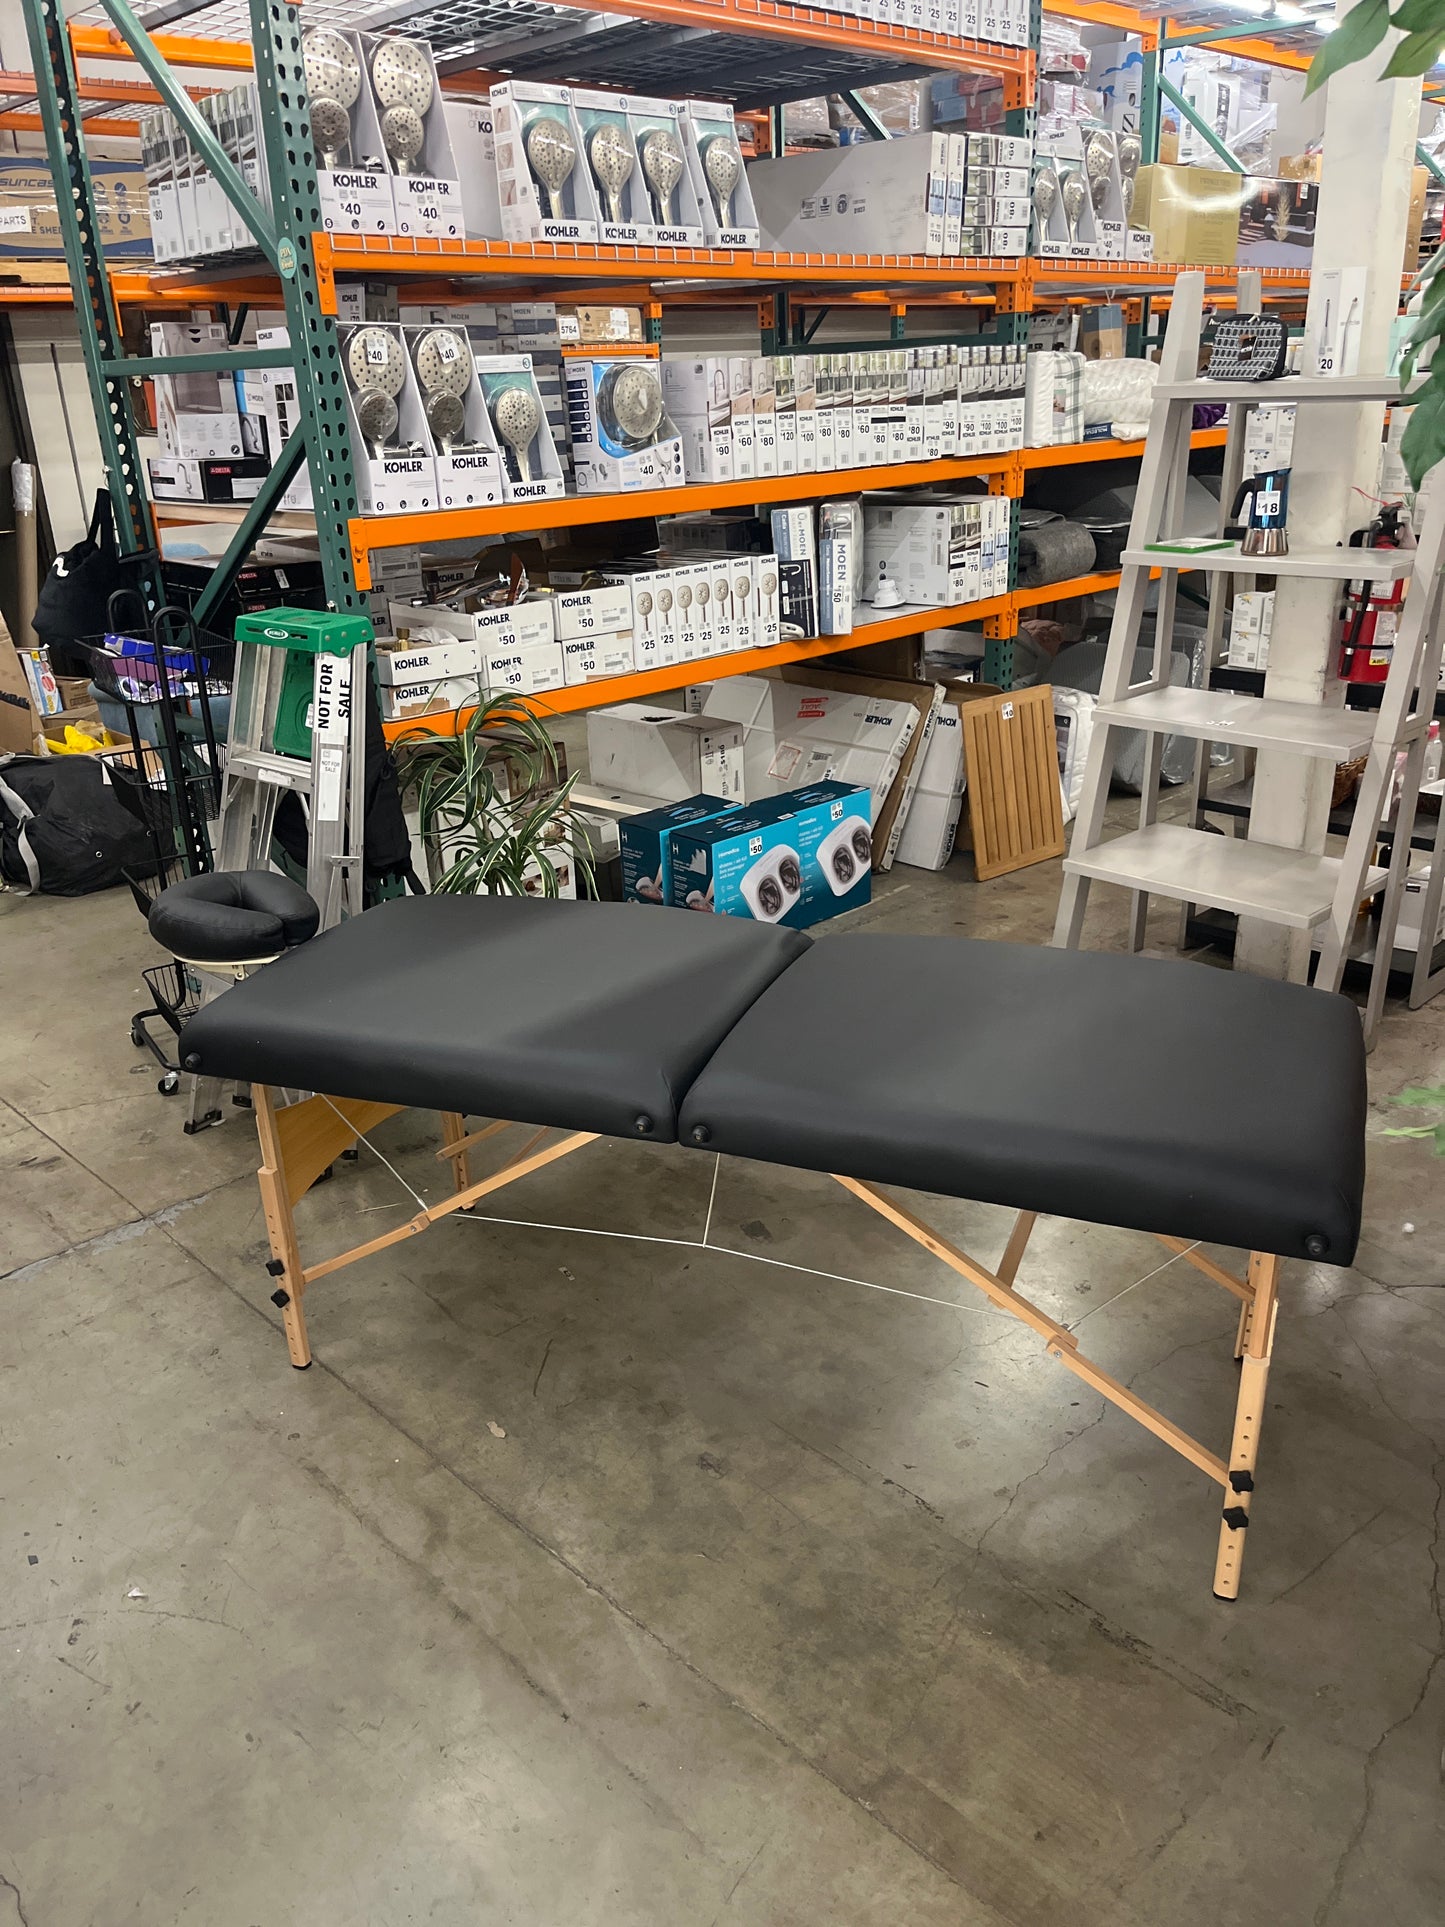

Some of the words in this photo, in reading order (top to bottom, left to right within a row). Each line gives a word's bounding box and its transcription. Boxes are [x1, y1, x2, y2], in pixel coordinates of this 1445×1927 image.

[0, 178, 54, 187] suncas
[332, 174, 378, 188] KOHLER
[340, 203, 361, 215] $40
[418, 208, 438, 219] $40
[544, 226, 579, 238] KOHLER
[1103, 222, 1122, 231] KOHLER
[657, 230, 687, 242] KOHLER
[720, 234, 746, 244] KOHLER
[1132, 234, 1151, 242] KOHLER
[1042, 246, 1060, 254] KOHLER
[1071, 248, 1090, 256] KOHLER
[368, 350, 382, 361] $40
[442, 348, 454, 360] $40
[384, 461, 423, 474] KOHLER
[452, 456, 488, 470] KOHLER
[640, 466, 654, 475] $40
[513, 485, 546, 498] KOHLER
[1258, 502, 1278, 514] $18
[837, 544, 846, 580] MOEN
[438, 572, 464, 583] KOHLER
[561, 596, 592, 608] KOHLER
[373, 617, 385, 626] LER
[478, 613, 510, 627] KOHLER
[579, 618, 594, 628] $50
[718, 626, 730, 634] $25
[737, 627, 749, 635] $25
[764, 624, 777, 633] $25
[499, 634, 515, 645] $50
[661, 634, 674, 643] $25
[681, 633, 694, 642] $25
[700, 632, 712, 640] $25
[566, 641, 595, 654] KOHLER
[642, 640, 655, 650] $25
[394, 656, 429, 670] KOHLER
[580, 660, 595, 670] $50
[320, 664, 333, 695] FOR
[506, 672, 522, 685] $50
[395, 686, 429, 700] KOHLER
[338, 680, 350, 718] SALE
[318, 698, 330, 729] NOT
[865, 715, 893, 726] KOHLER
[924, 709, 935, 738] KOHLER
[936, 716, 957, 728] KOHL
[832, 809, 843, 819] $50
[946, 823, 956, 852] KOHLER
[750, 844, 762, 854] $50
